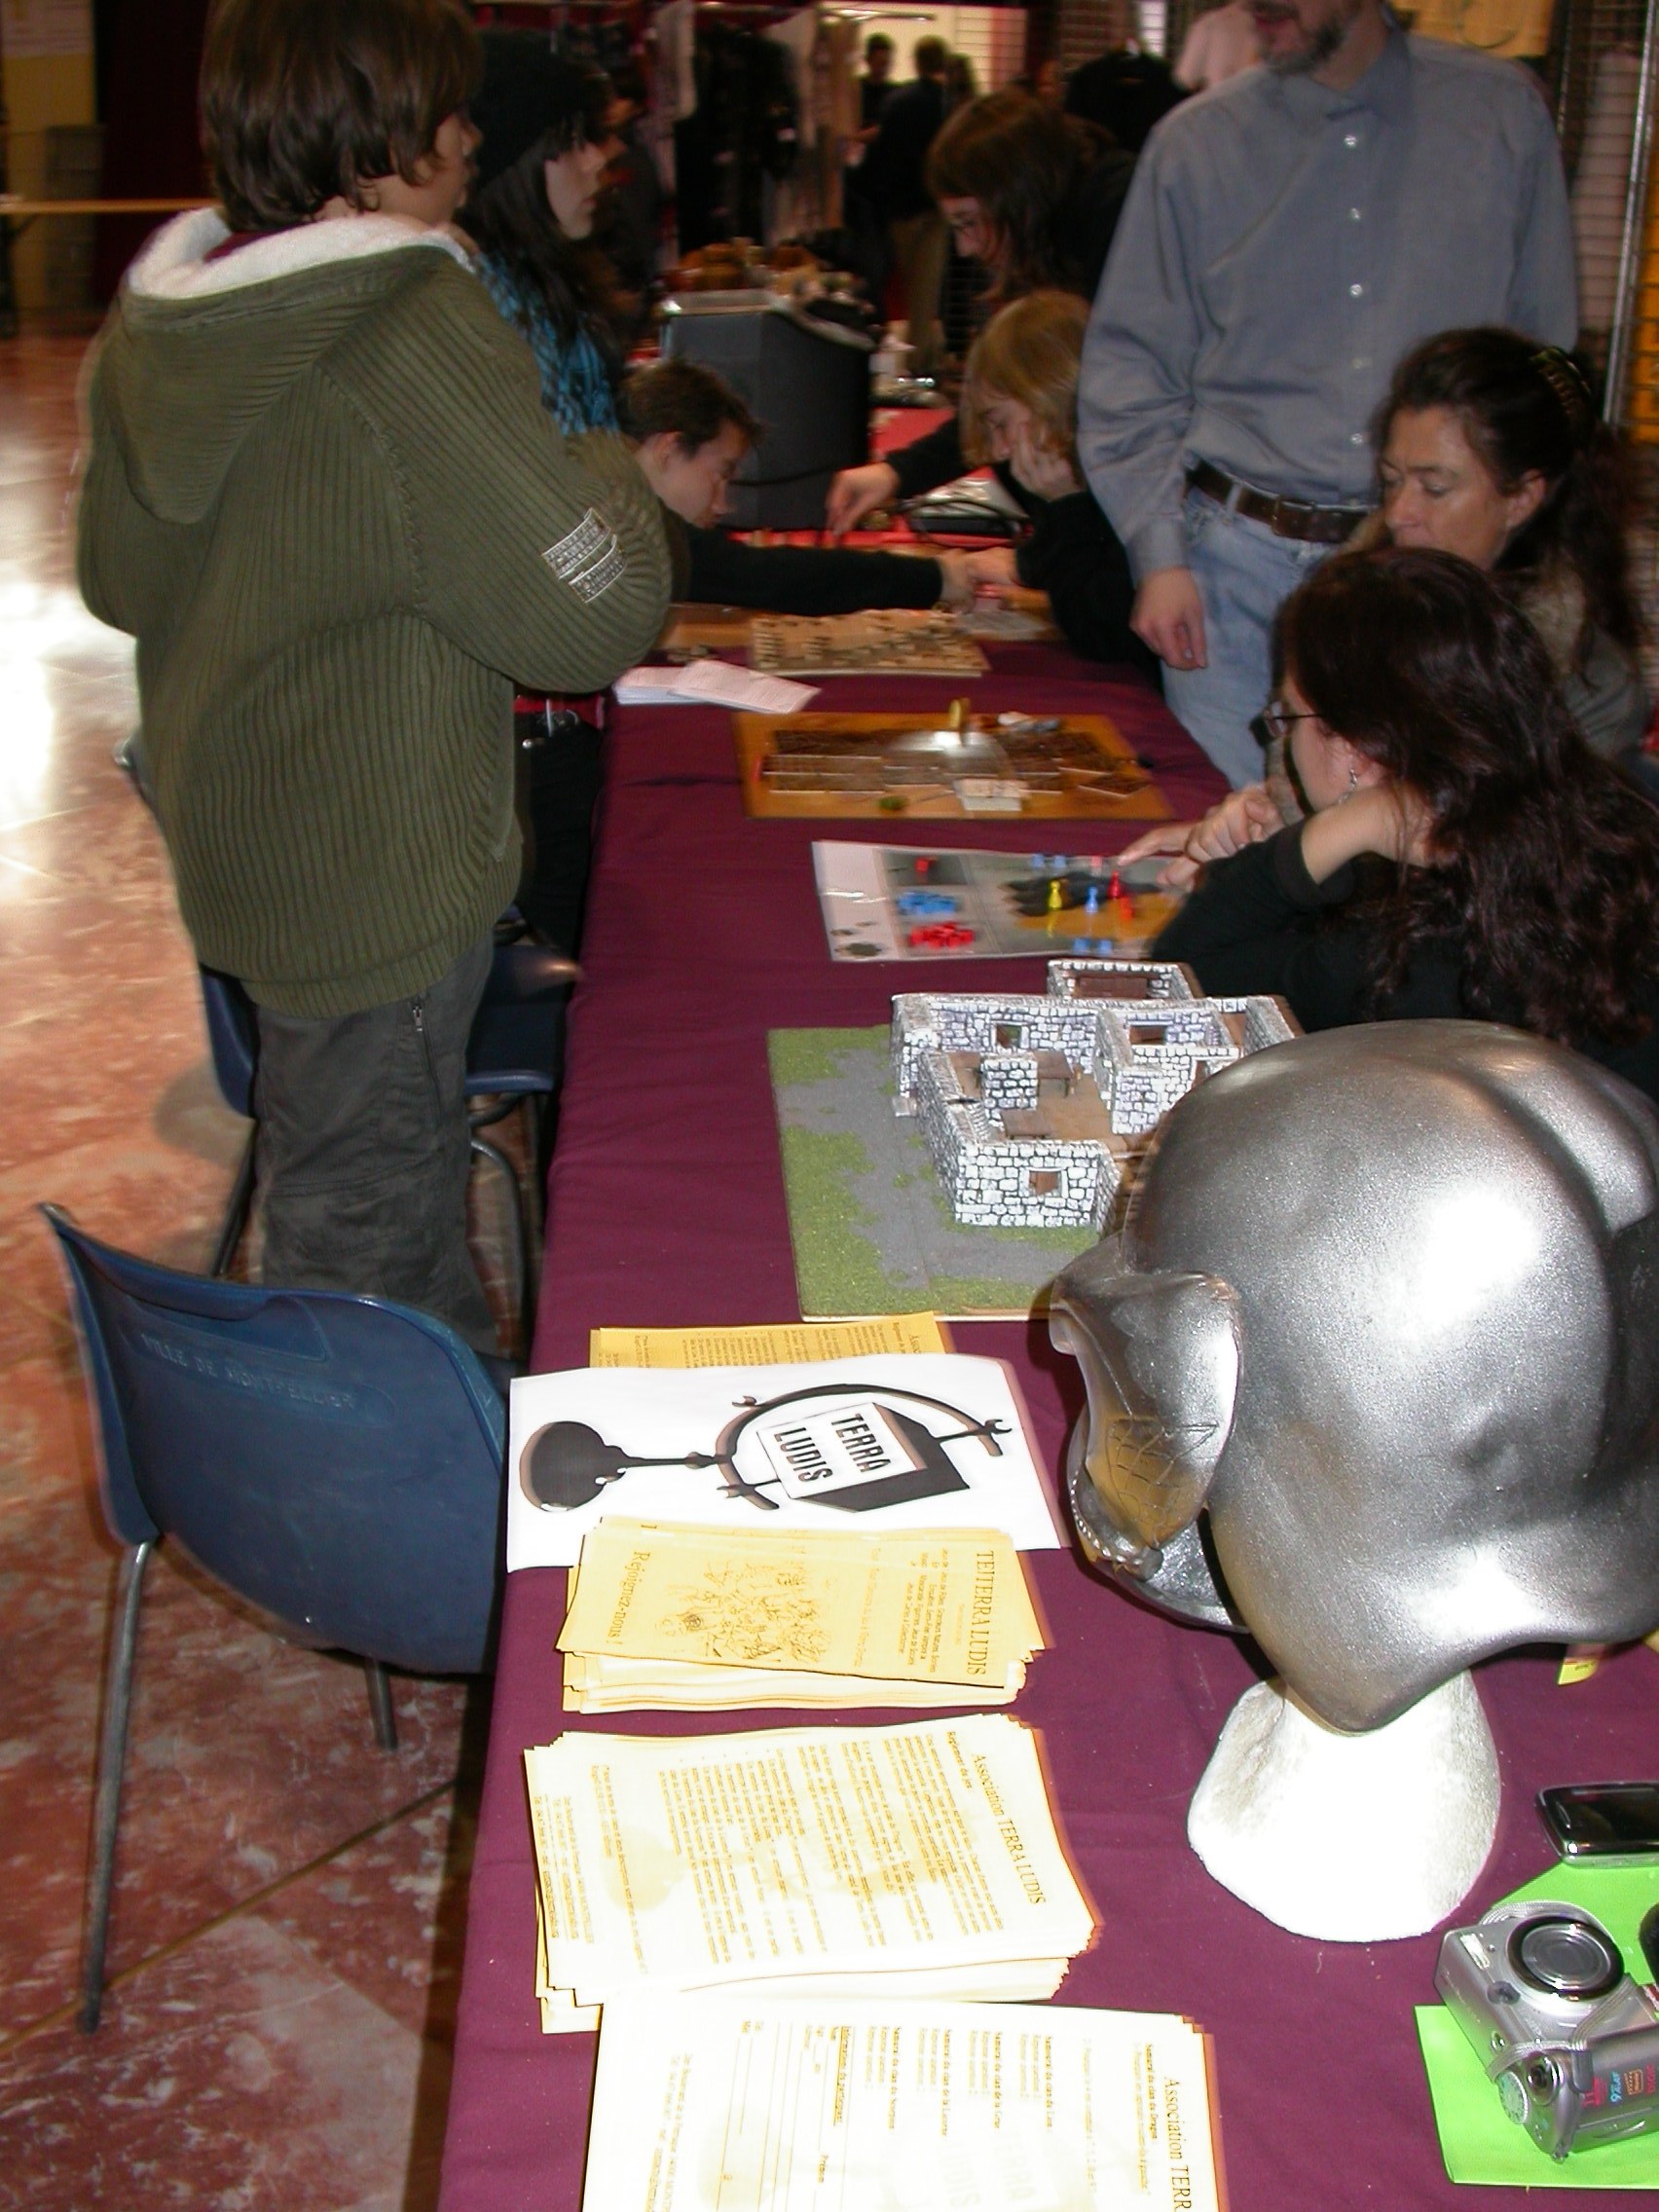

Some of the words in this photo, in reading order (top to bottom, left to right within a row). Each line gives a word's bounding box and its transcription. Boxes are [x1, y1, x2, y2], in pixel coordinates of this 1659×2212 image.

[195, 1356, 218, 1378] DE
[773, 1426, 833, 1483] LUDIS
[830, 1413, 891, 1473] TERRA
[972, 1574, 995, 1627] TERRA
[966, 1629, 990, 1676] LUDIS
[972, 1753, 1005, 1817] Association
[996, 1818, 1026, 1862] TERRA
[1014, 1863, 1047, 1906] LUDIS
[1164, 2076, 1187, 2160] Association
[1170, 2164, 1193, 2212] TERR
